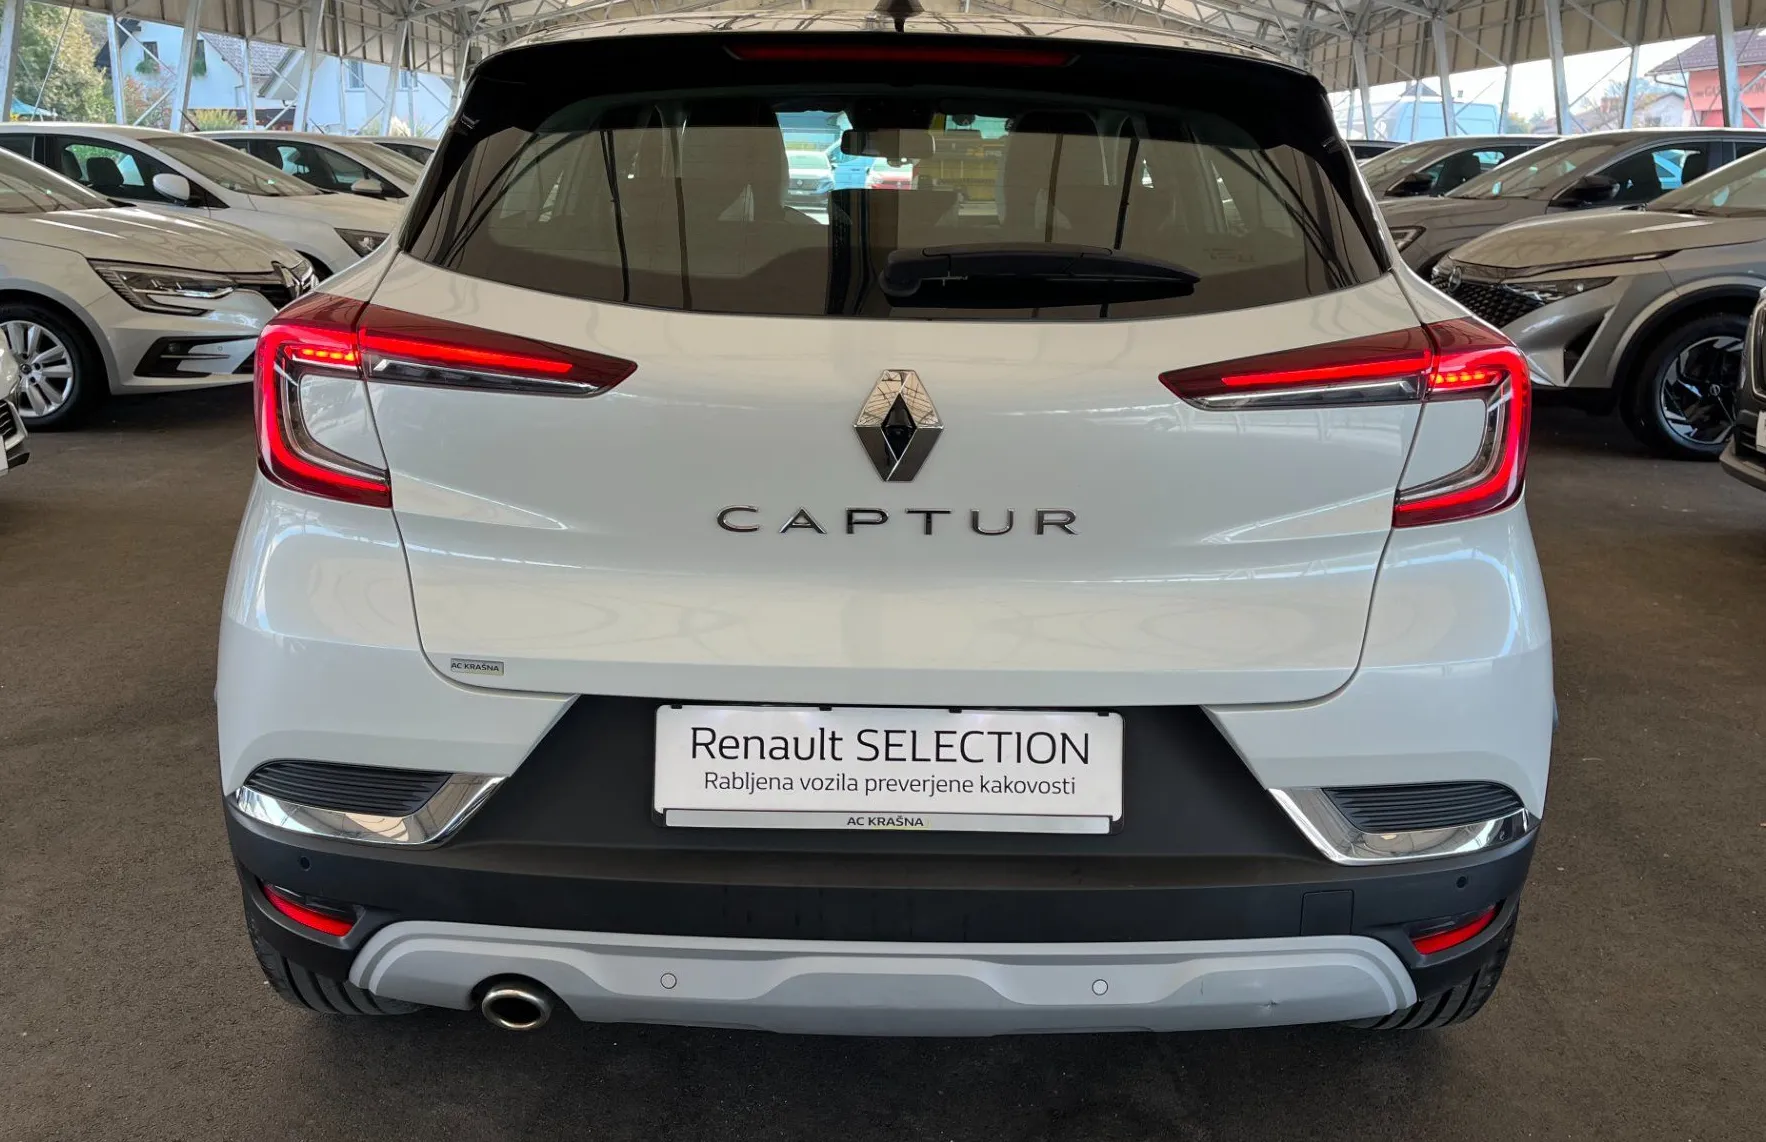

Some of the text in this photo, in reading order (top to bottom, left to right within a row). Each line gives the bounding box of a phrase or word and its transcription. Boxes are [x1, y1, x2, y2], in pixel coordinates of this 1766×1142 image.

[716, 504, 1079, 535] CAPTUR
[464, 663, 500, 672] KRAŠNA
[691, 727, 1089, 765] Renault SELECTION
[704, 771, 1076, 797] Rabljena vozila preverjene kakovosti
[847, 815, 924, 827] AC KRAŠNA
